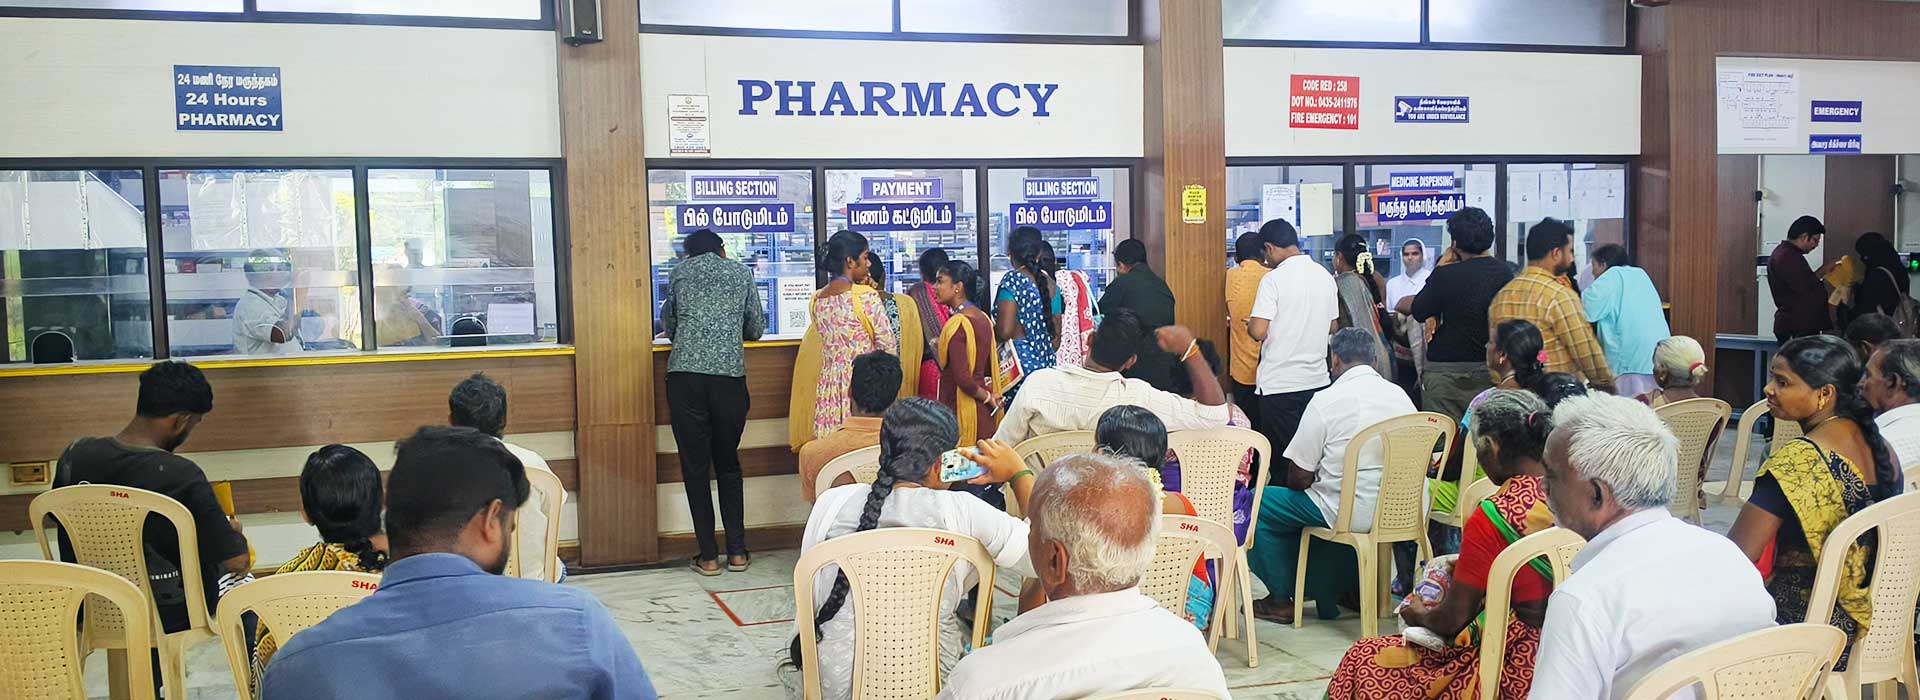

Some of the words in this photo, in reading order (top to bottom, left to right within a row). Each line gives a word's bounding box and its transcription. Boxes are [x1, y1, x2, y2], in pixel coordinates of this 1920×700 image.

[178, 73, 190, 85] 24
[1302, 79, 1320, 91] CODE
[1320, 80, 1333, 92] RED
[185, 93, 208, 106] 24
[214, 93, 267, 107] Hours
[737, 79, 1059, 118] PHARMACY
[1291, 112, 1305, 124] FIRE
[1305, 112, 1342, 125] EMERGENCY
[1346, 113, 1357, 125] 101
[1814, 107, 1859, 116] EMERGENCY
[179, 113, 281, 127] PHARMACY
[695, 180, 733, 196] BILLING
[735, 180, 777, 196] SECTION
[872, 181, 932, 196] PAYMENT
[1026, 180, 1060, 196] BILLING
[1061, 180, 1097, 196] SECTION
[1391, 176, 1419, 188] MEDICINE
[1420, 175, 1454, 187] DISPENSING
[1379, 197, 1408, 219] மருந்து
[683, 206, 710, 227] பில்
[713, 206, 789, 230] போடுமிடம்
[851, 206, 889, 225] பணம்
[892, 204, 952, 229] கட்டுமிடம்
[1015, 206, 1038, 225] பில்
[1040, 204, 1107, 227] போடுமிடம்
[1180, 522, 1199, 532] SHA
[934, 536, 955, 546] SHA
[351, 580, 378, 590] SHA
